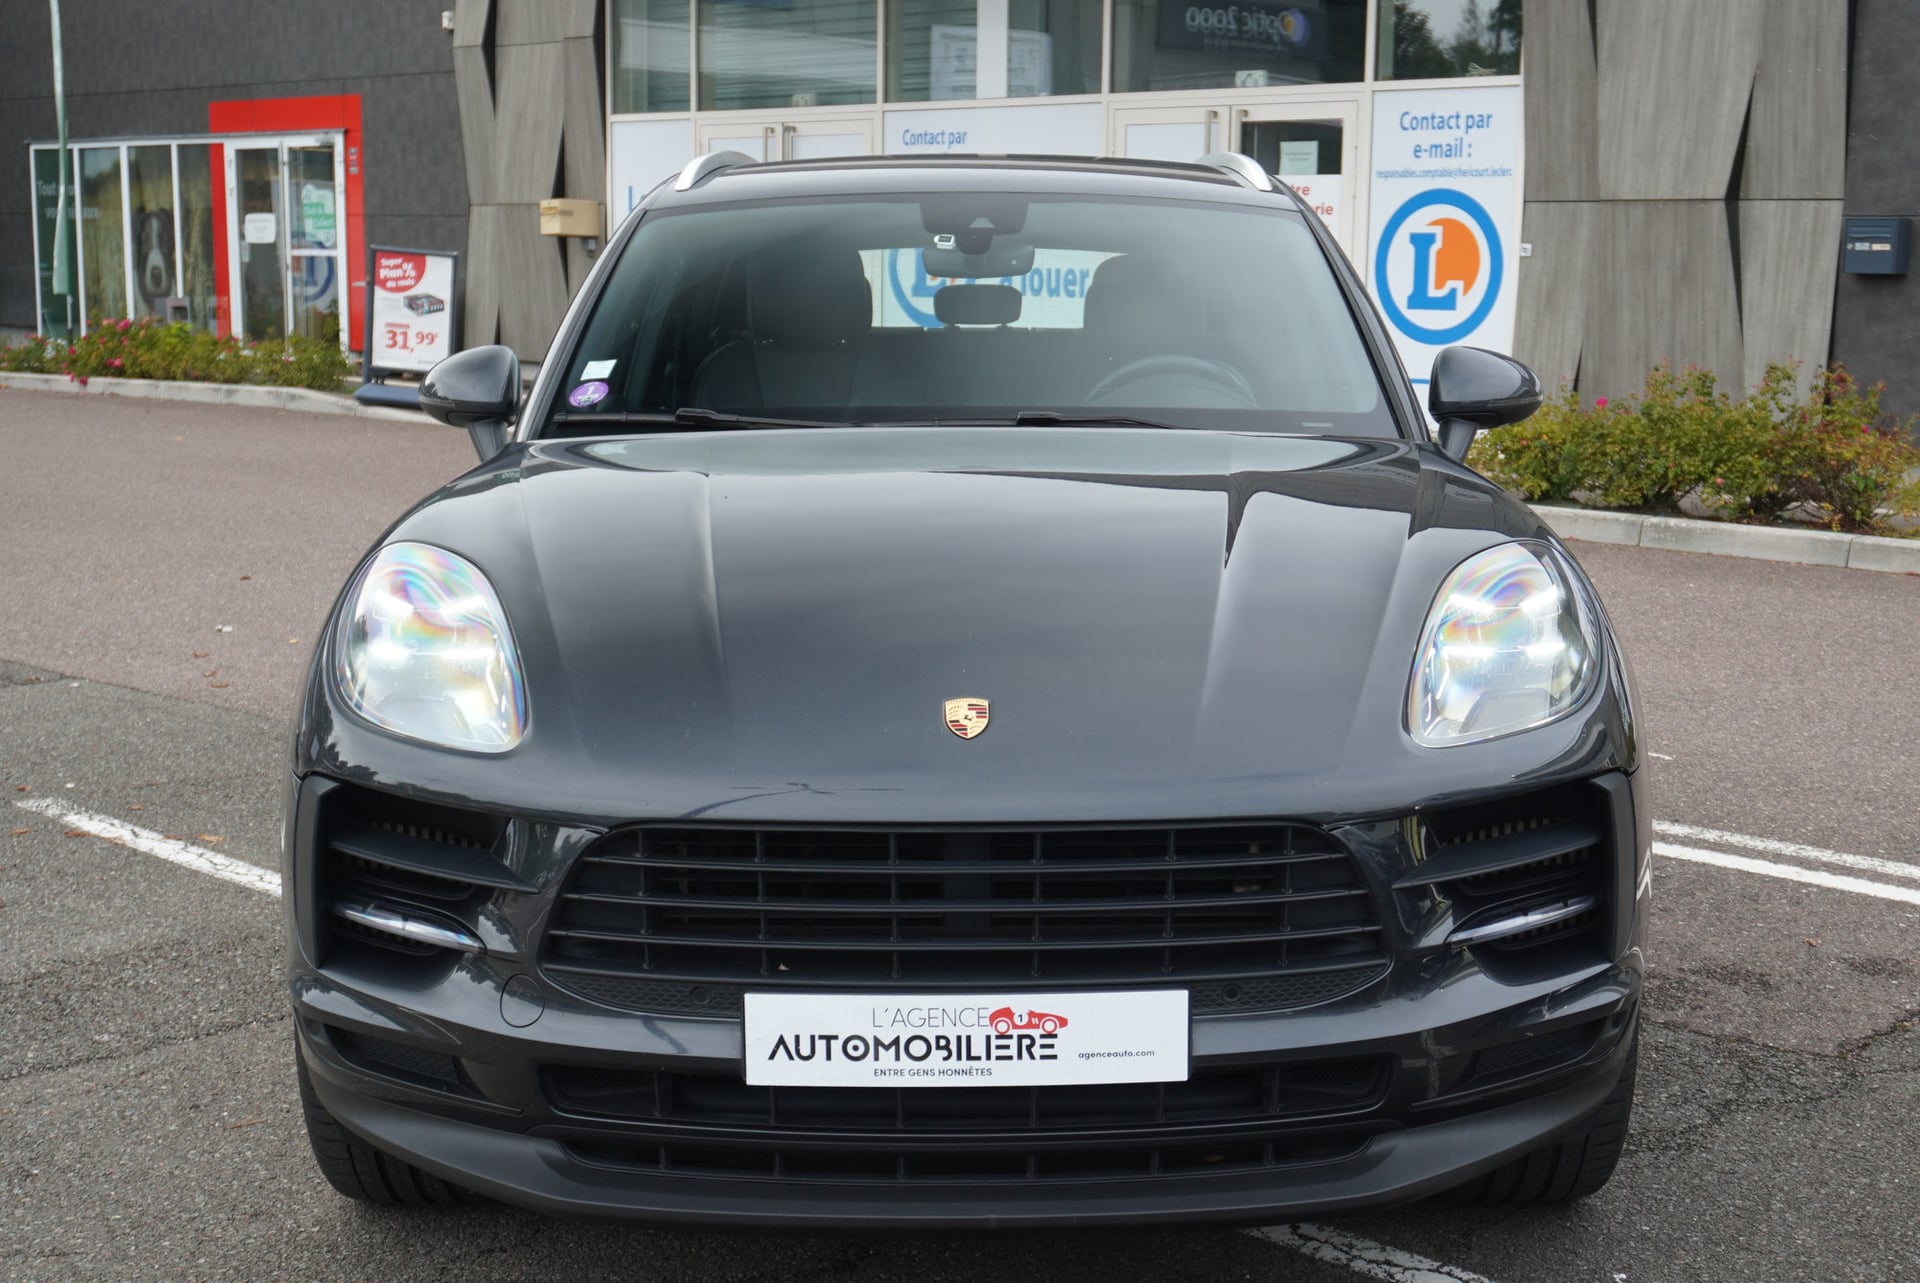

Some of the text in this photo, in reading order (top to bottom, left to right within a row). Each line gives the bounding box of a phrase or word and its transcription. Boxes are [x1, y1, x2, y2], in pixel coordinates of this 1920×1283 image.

[1400, 111, 1493, 135] Contact par
[902, 128, 967, 149] Contact par
[1413, 136, 1463, 159] e-mail
[380, 258, 403, 267] Super
[872, 1006, 989, 1029] L'AGENCE
[1077, 1048, 1156, 1060] agenceauto.com
[874, 1066, 993, 1078] ENTRE GENS HONNÊTES
